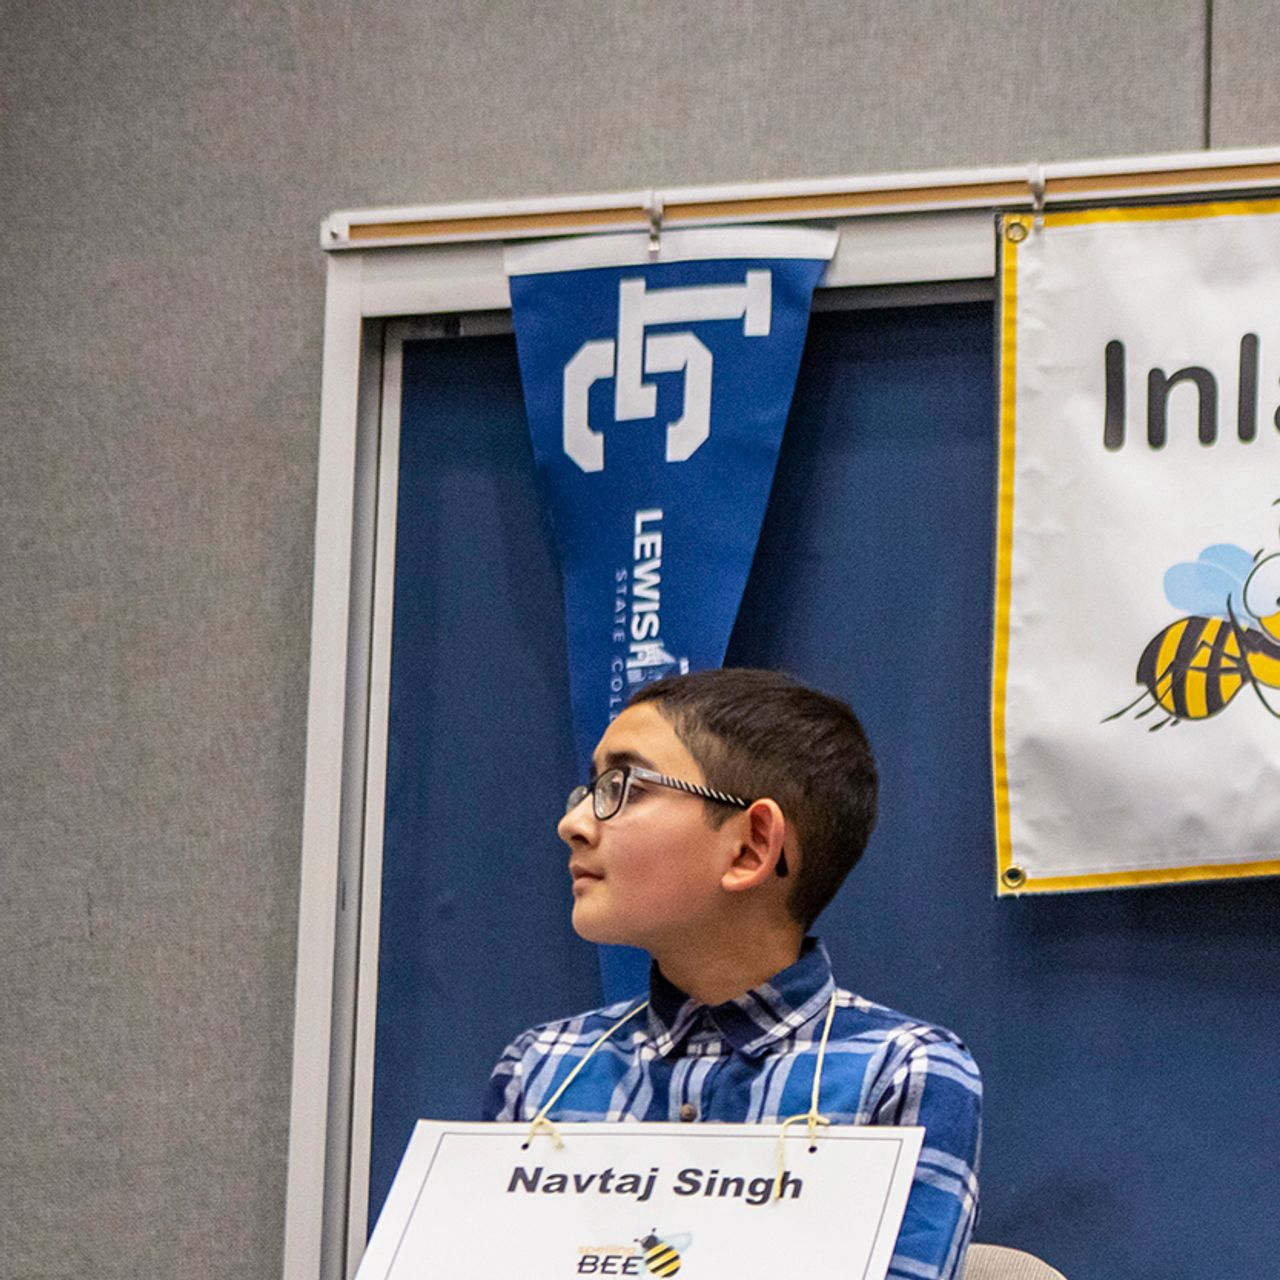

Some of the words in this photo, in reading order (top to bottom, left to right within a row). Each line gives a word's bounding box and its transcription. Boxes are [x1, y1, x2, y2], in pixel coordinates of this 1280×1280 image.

[630, 508, 665, 641] LEWIS
[612, 567, 629, 643] STATE
[506, 1165, 661, 1203] Navtaj
[671, 1167, 804, 1207] Singh
[577, 1254, 645, 1276] BEE
